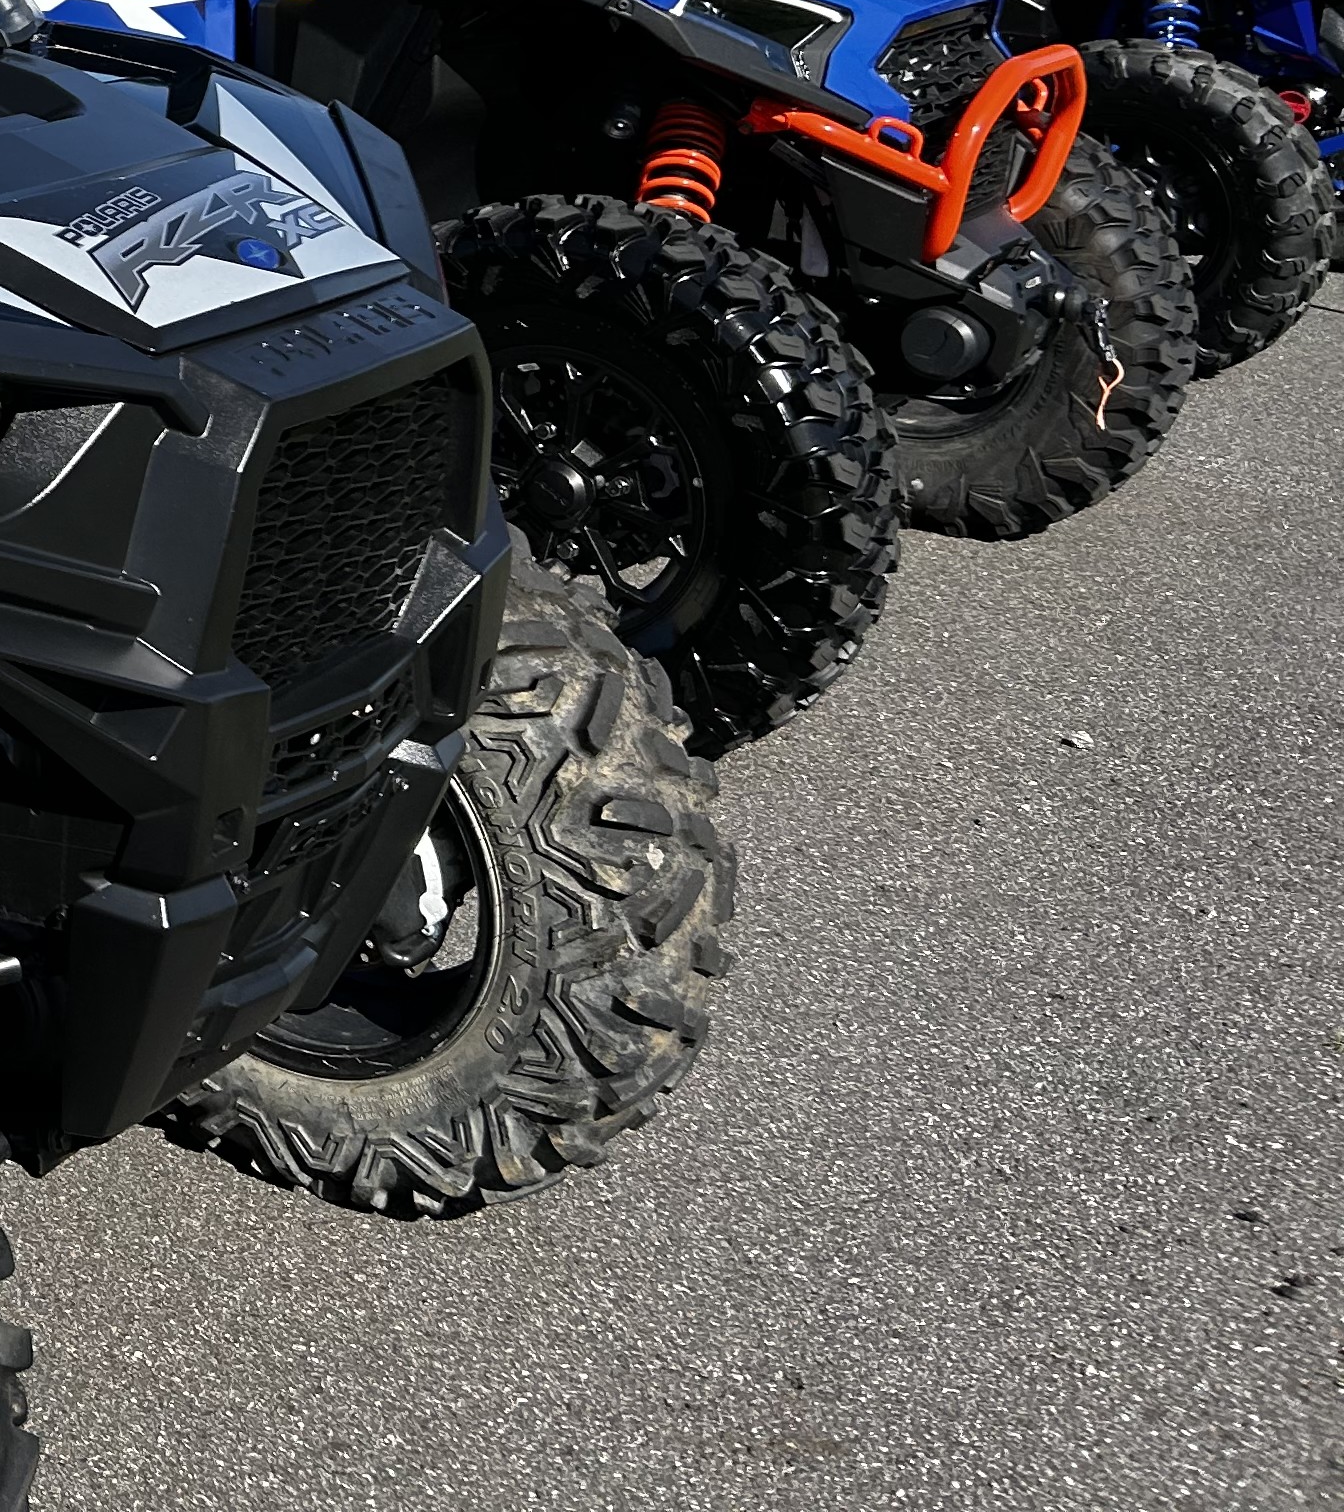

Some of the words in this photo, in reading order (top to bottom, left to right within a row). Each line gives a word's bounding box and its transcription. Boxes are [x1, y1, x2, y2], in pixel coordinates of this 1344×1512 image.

[53, 185, 164, 248] POLARIS
[86, 170, 310, 315] RZR
[267, 200, 349, 251] XC
